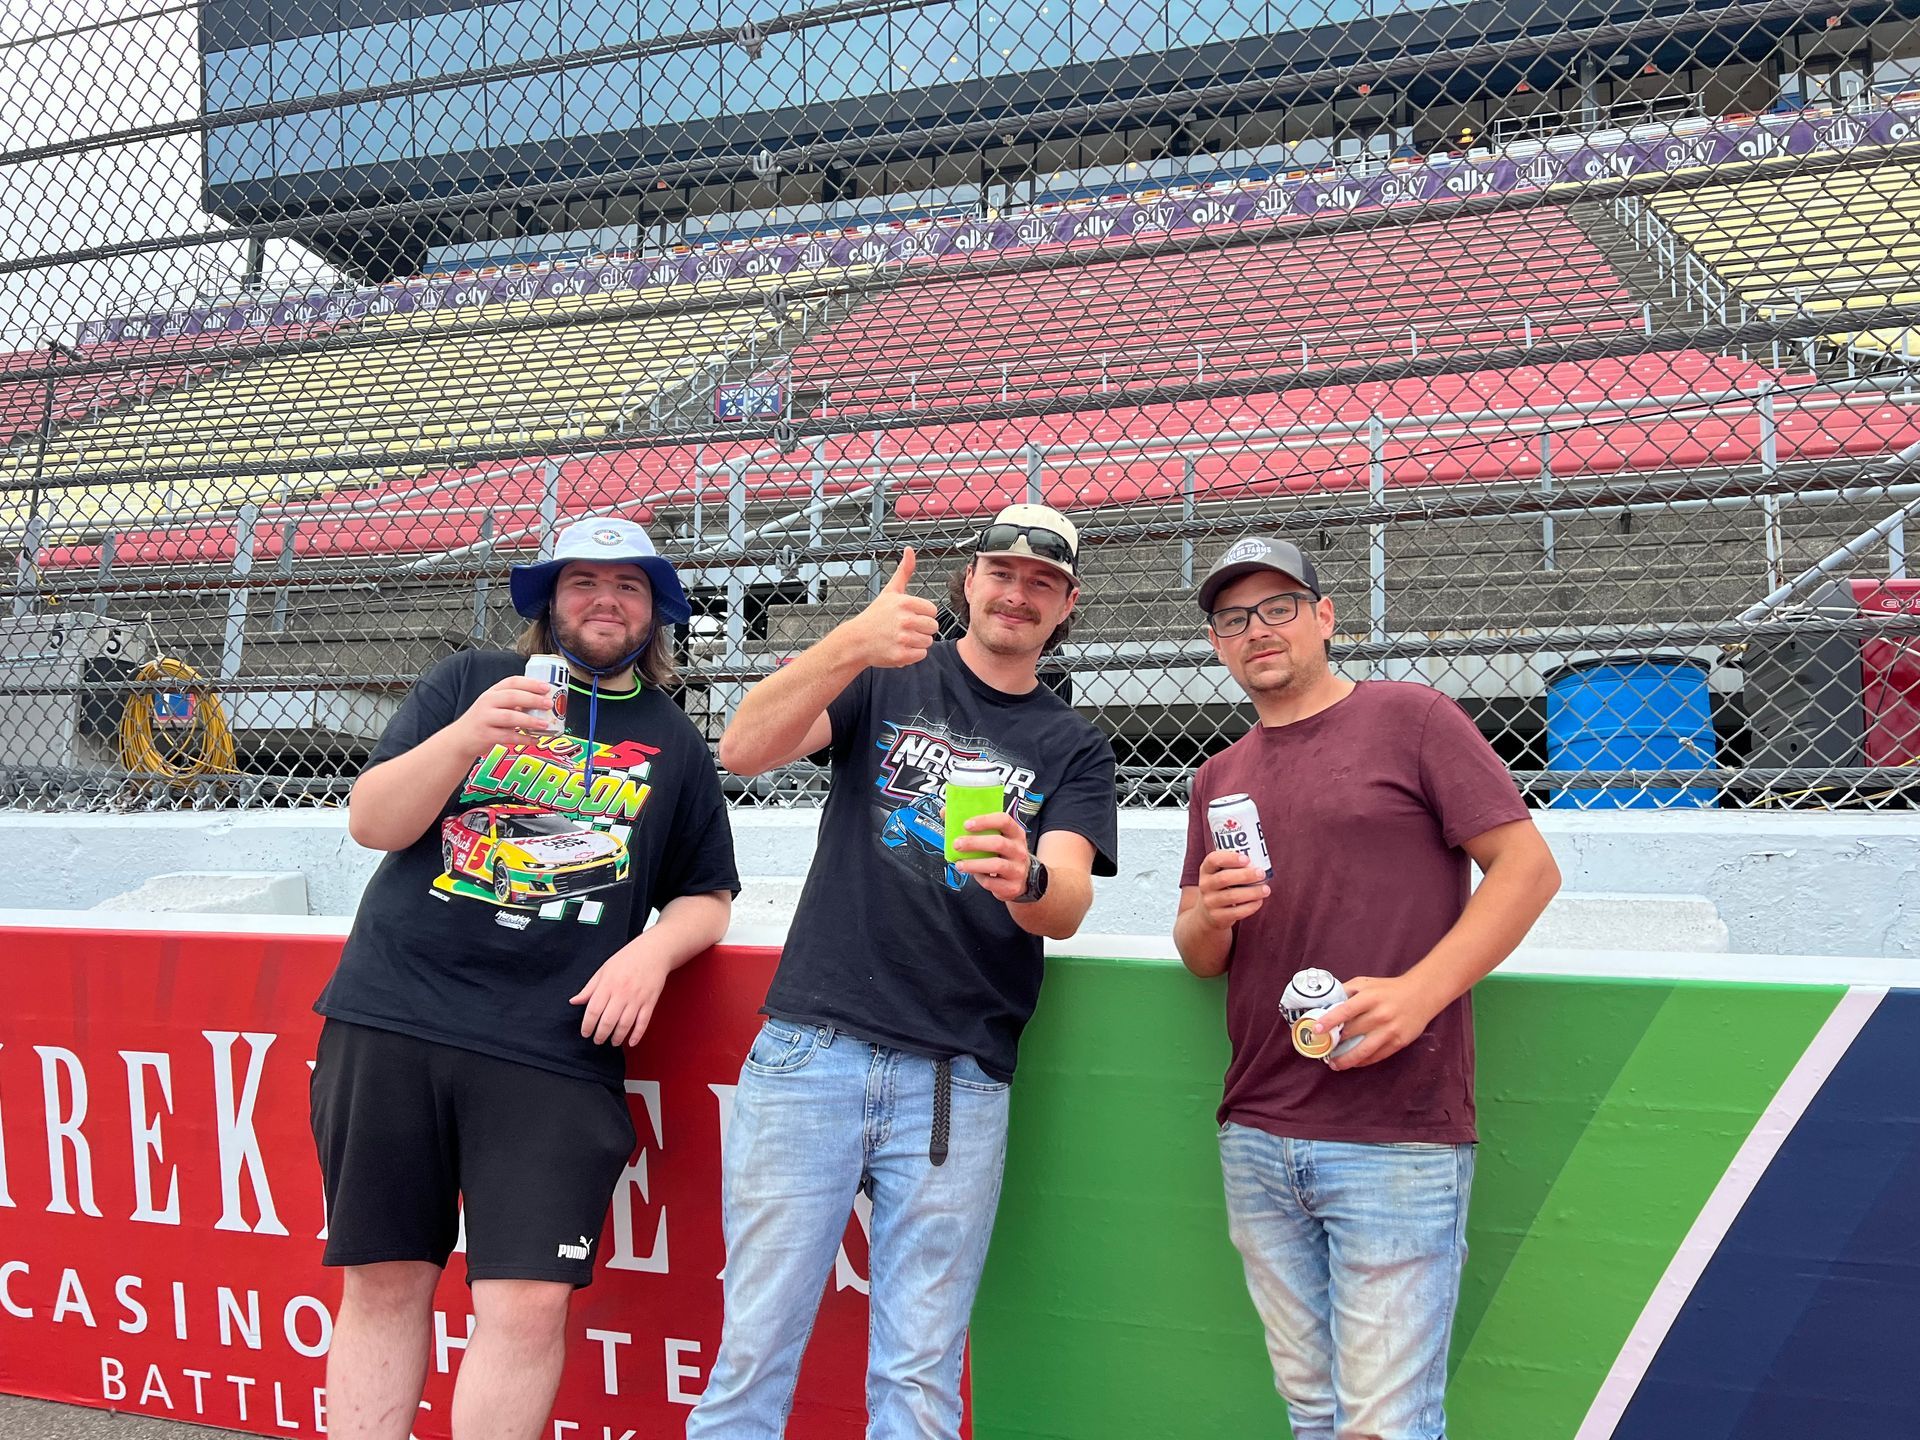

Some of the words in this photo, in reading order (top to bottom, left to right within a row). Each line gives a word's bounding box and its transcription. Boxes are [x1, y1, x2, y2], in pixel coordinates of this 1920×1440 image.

[600, 267, 633, 288] ally
[648, 265, 681, 285] ally
[696, 255, 732, 278] ally
[746, 254, 782, 274] ally
[800, 242, 832, 265] ally
[849, 242, 886, 263] ally
[902, 231, 939, 252] ally
[956, 229, 994, 250] ally
[1018, 219, 1057, 243] ally
[1074, 215, 1115, 237] ally
[1133, 206, 1174, 230] ally
[1192, 202, 1235, 223] ally
[1256, 188, 1296, 212] ally
[1316, 185, 1361, 208] ally
[1381, 173, 1427, 199] ally
[1446, 169, 1495, 194] ally
[1515, 156, 1564, 181] ally
[1584, 153, 1634, 178] ally
[1665, 137, 1716, 164] ally
[1738, 132, 1790, 157] ally
[1813, 118, 1866, 145] ally
[471, 743, 652, 820] LARSON
[468, 842, 492, 870] 5
[1213, 831, 1249, 850] lue
[557, 1244, 587, 1260] PUMA
[0, 1260, 334, 1358] CASINO
